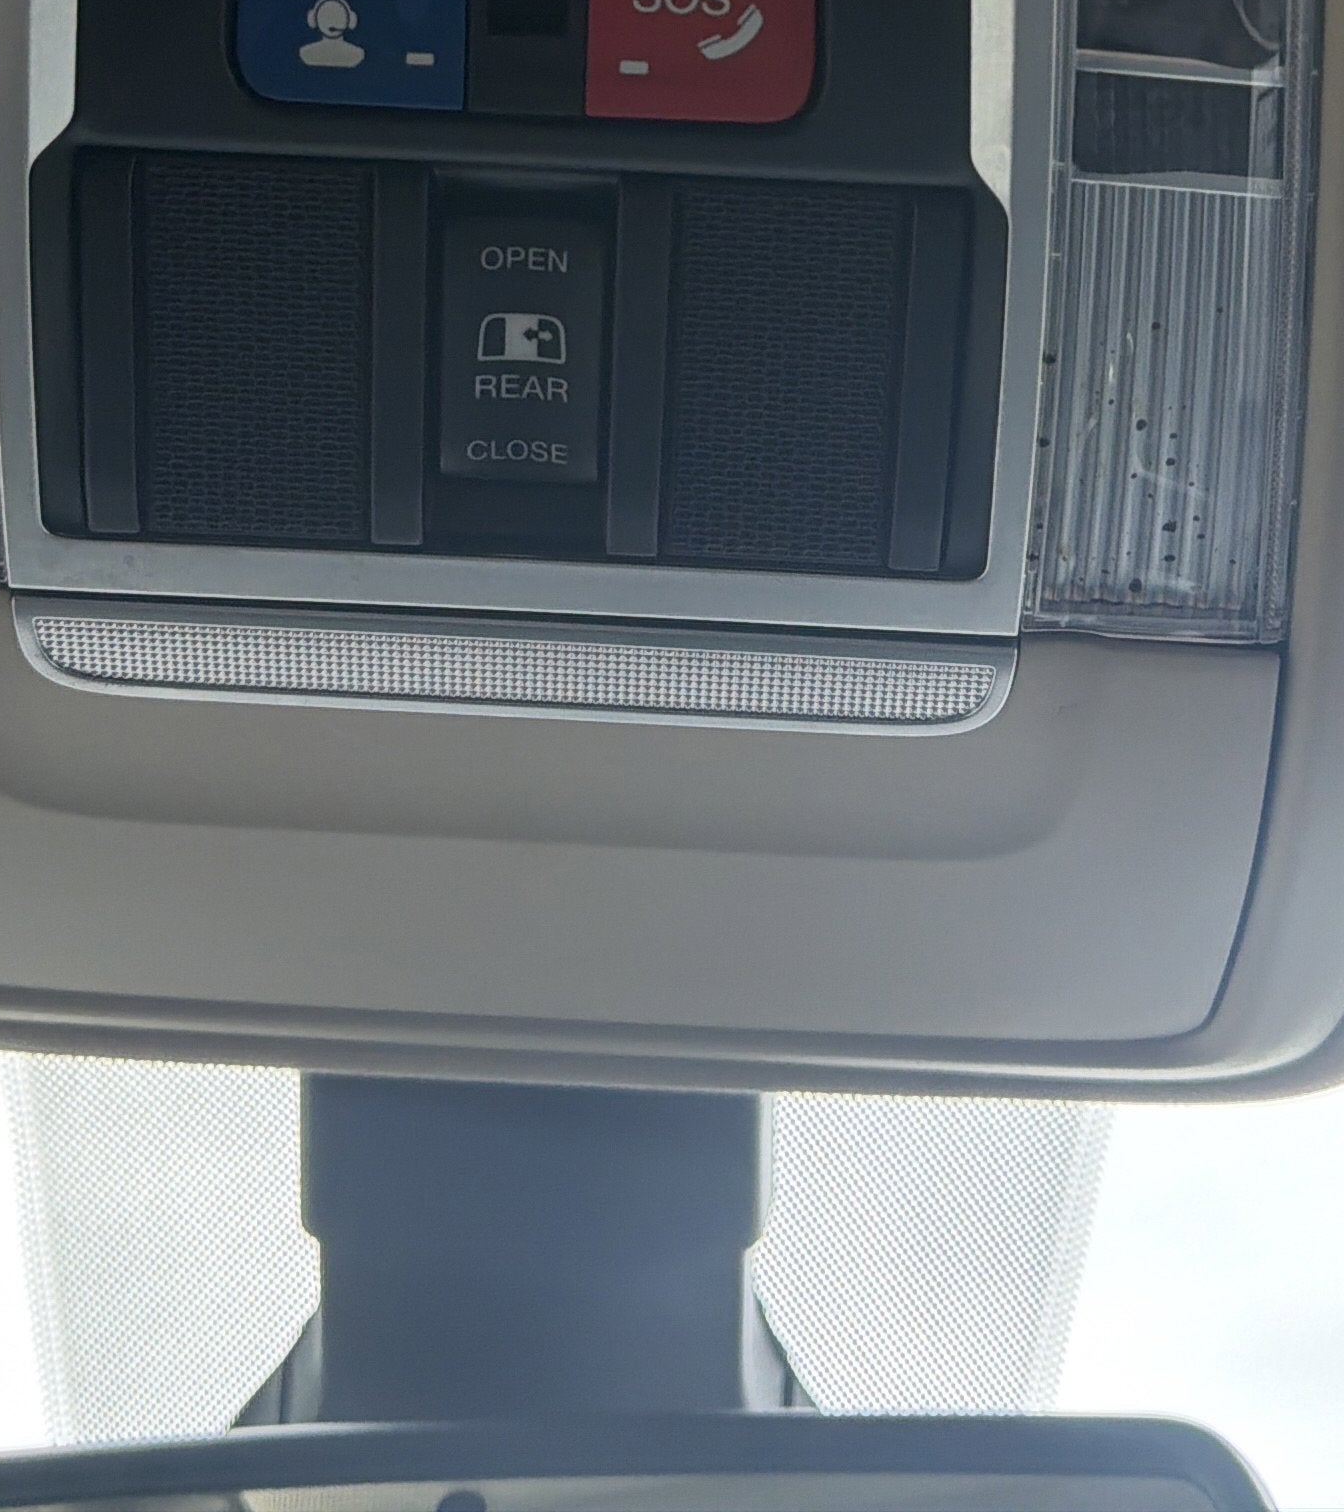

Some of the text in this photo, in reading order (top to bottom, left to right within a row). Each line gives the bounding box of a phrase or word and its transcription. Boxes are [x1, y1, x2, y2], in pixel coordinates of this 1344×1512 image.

[480, 246, 568, 273] OPEN
[474, 374, 568, 403] REAR
[466, 440, 568, 465] CLOSE
